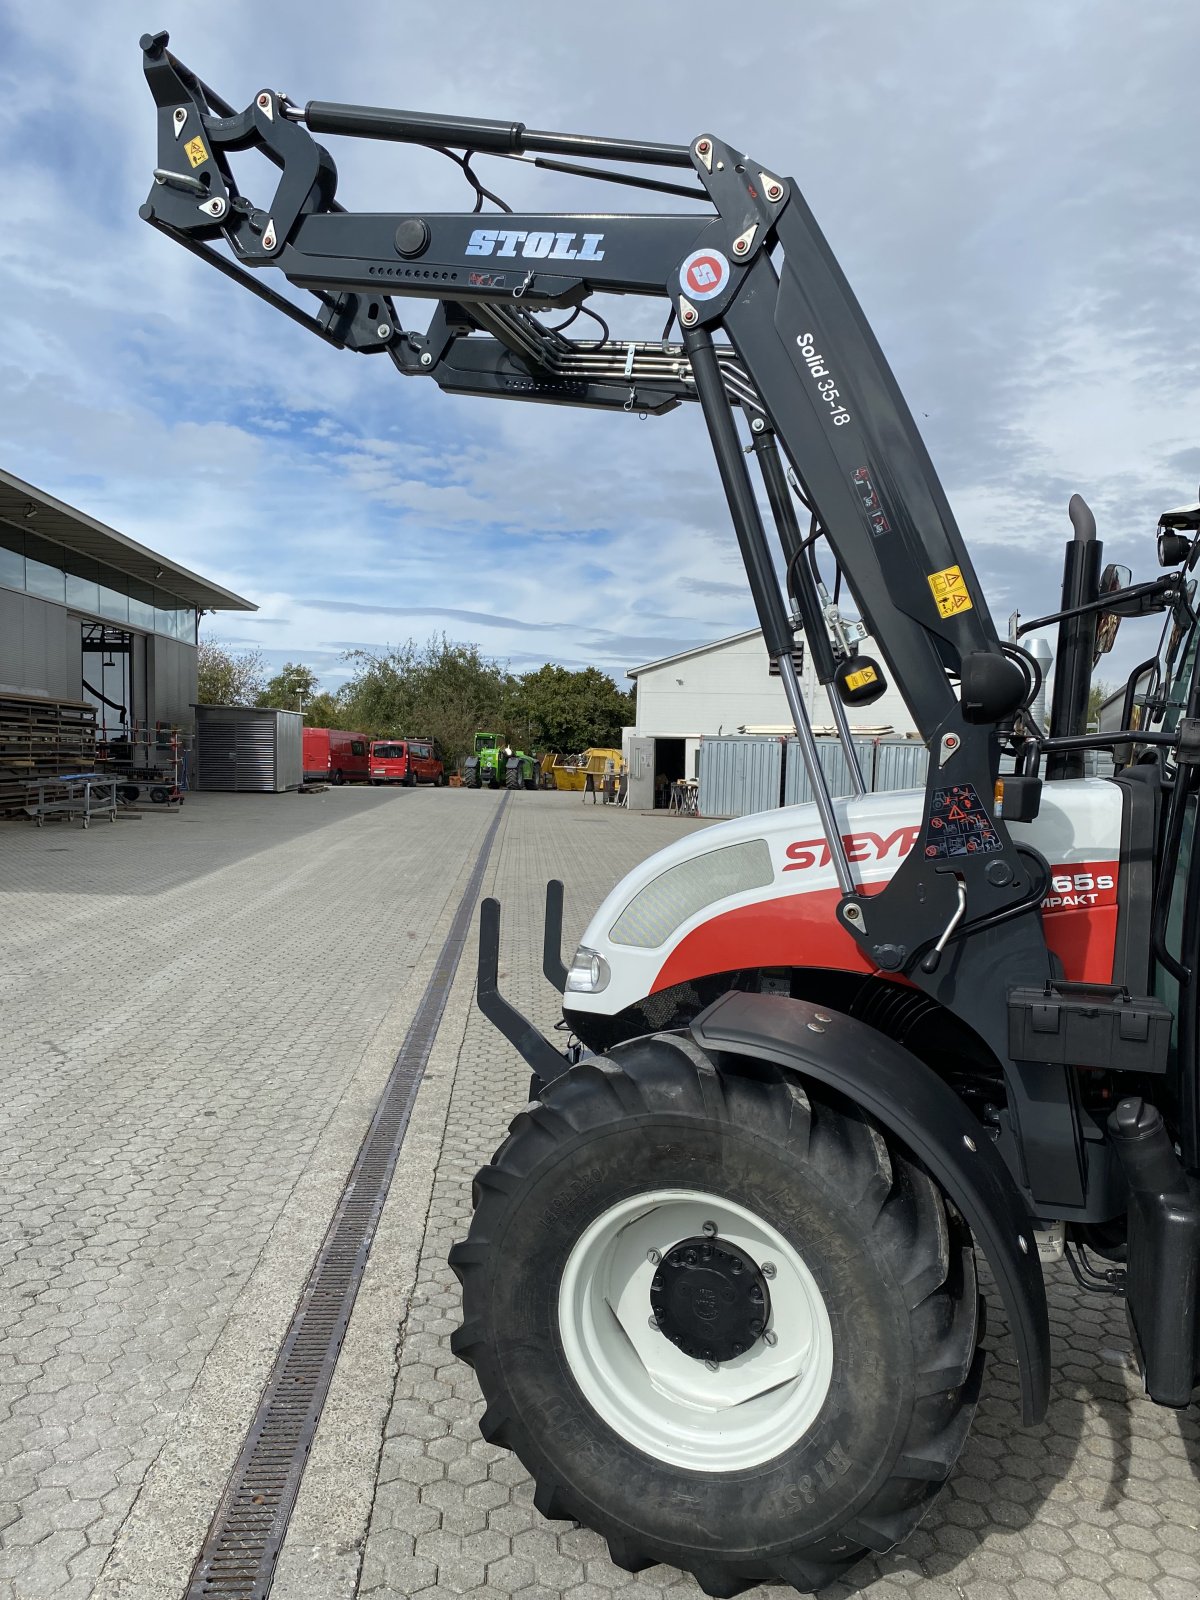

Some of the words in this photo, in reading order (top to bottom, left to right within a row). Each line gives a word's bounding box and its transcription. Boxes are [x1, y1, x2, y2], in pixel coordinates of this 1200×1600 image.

[465, 229, 605, 261] STOLL
[796, 333, 829, 378] Solid
[817, 379, 851, 426] 35-18
